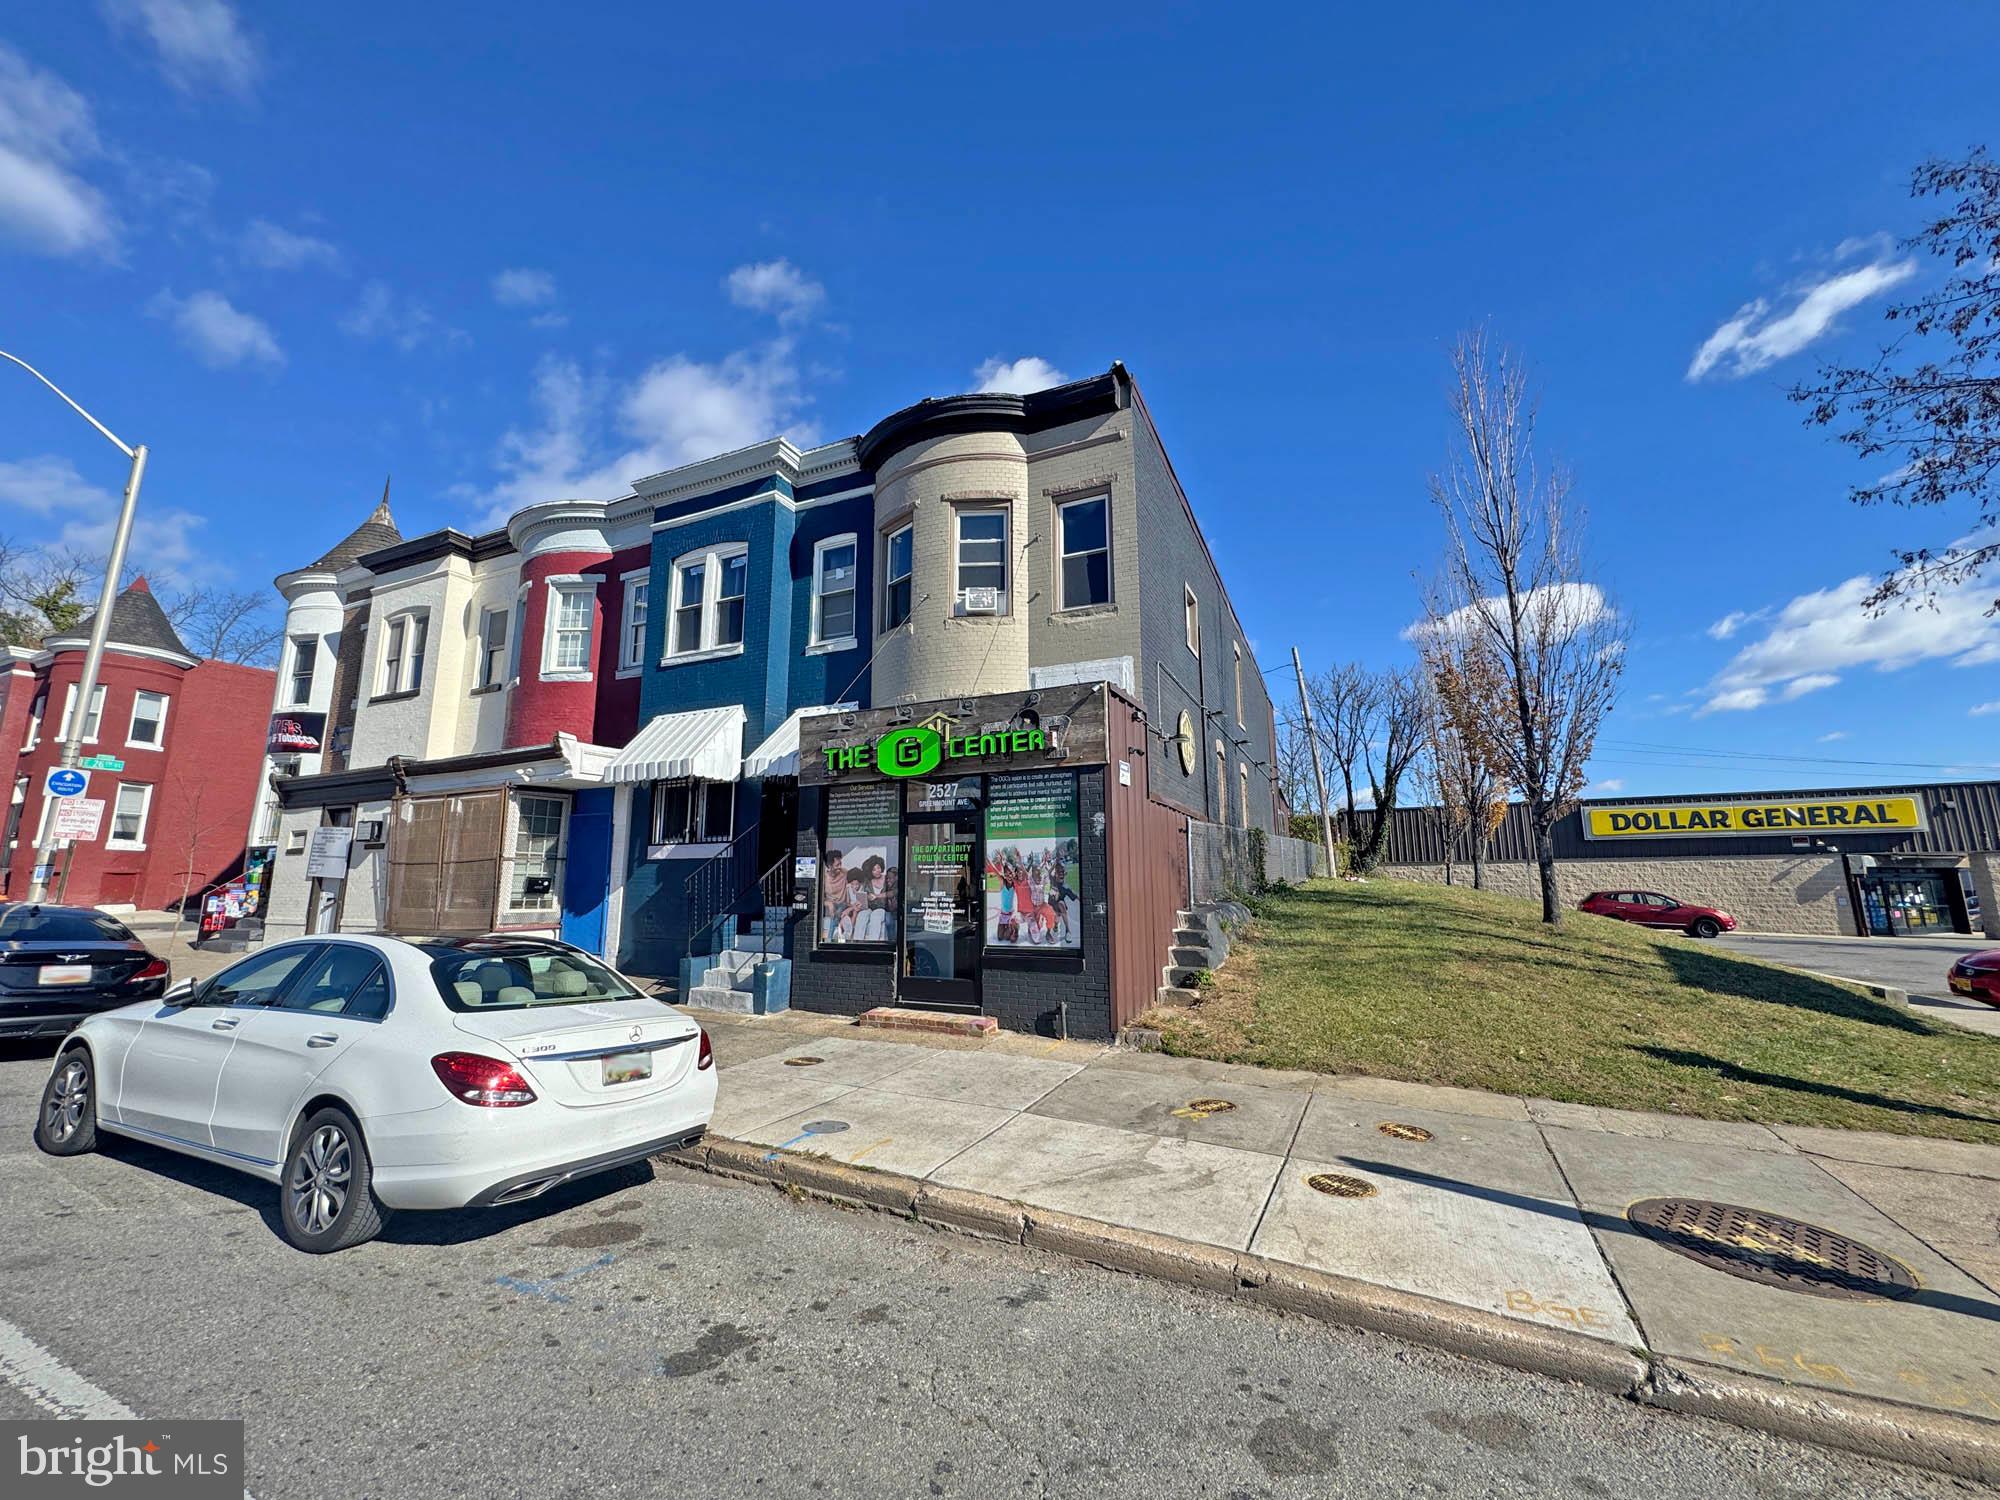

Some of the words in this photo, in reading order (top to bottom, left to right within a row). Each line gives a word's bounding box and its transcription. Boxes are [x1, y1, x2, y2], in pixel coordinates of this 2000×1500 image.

[278, 733, 320, 745] Tobacco
[823, 745, 871, 770] THE
[950, 729, 1045, 758] CENTER
[929, 783, 959, 798] 2527
[919, 799, 955, 808] GREENMOUNT
[1609, 810, 1731, 831] DOLLAR
[1741, 804, 1899, 828] GENERAL
